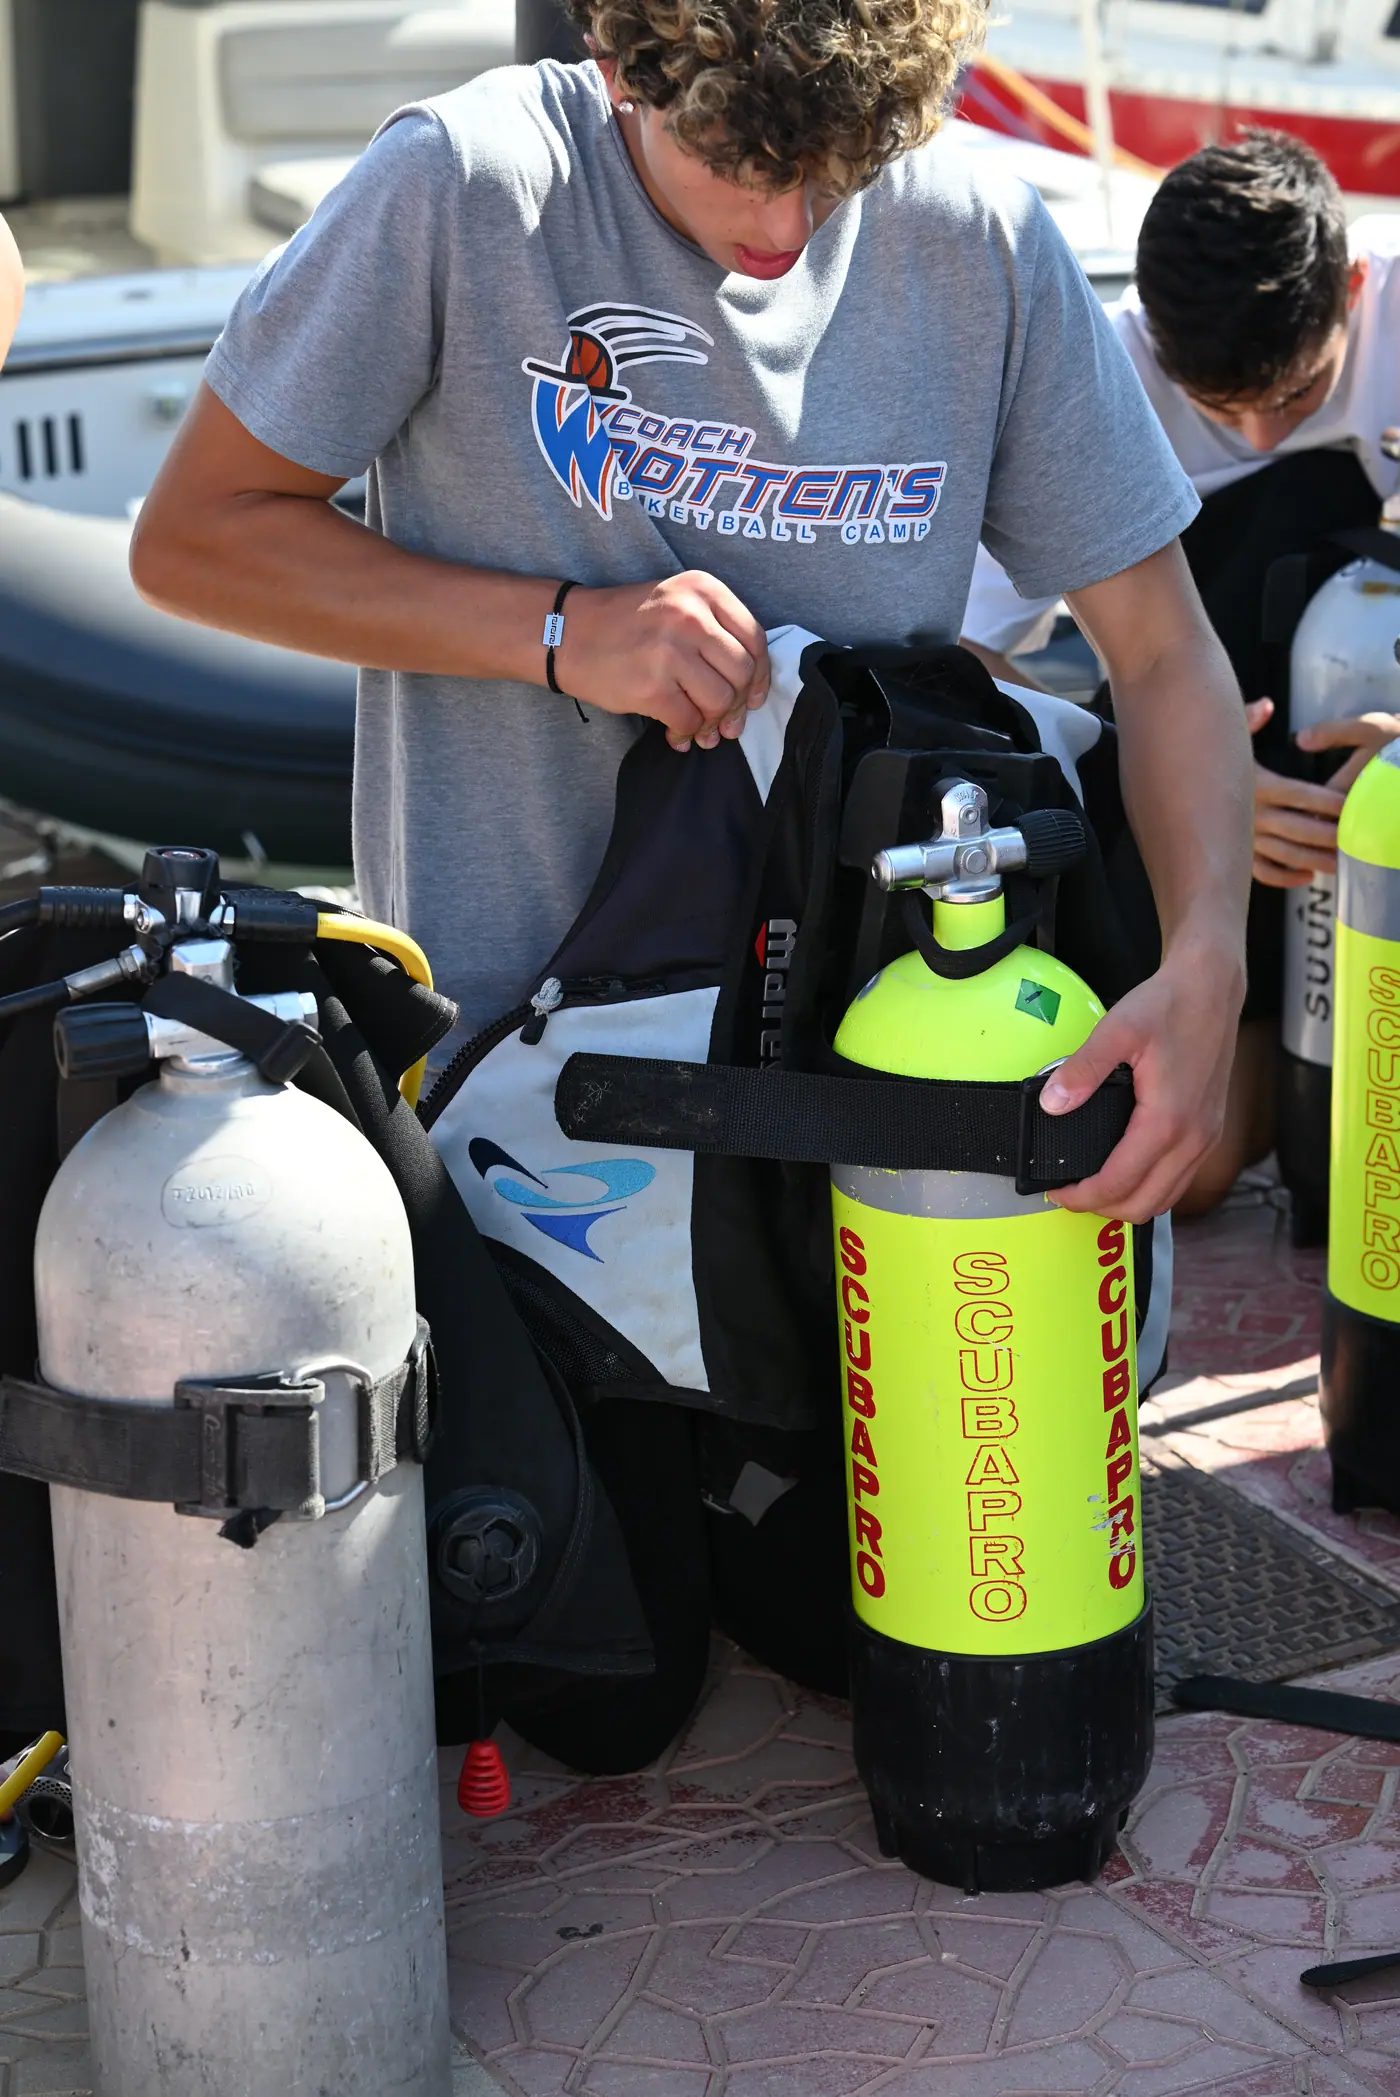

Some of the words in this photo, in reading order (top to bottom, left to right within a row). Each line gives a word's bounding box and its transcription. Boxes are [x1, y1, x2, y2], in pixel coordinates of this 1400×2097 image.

[608, 407, 752, 456] COACH
[617, 481, 814, 540] BKETBALL
[845, 522, 929, 541] CAMP
[1305, 886, 1332, 1022] SUUN
[839, 1226, 885, 1598] SCUBAPRO
[952, 1251, 1027, 1622] SCUBAPRO
[1097, 1219, 1136, 1590] SCUBAPRO
